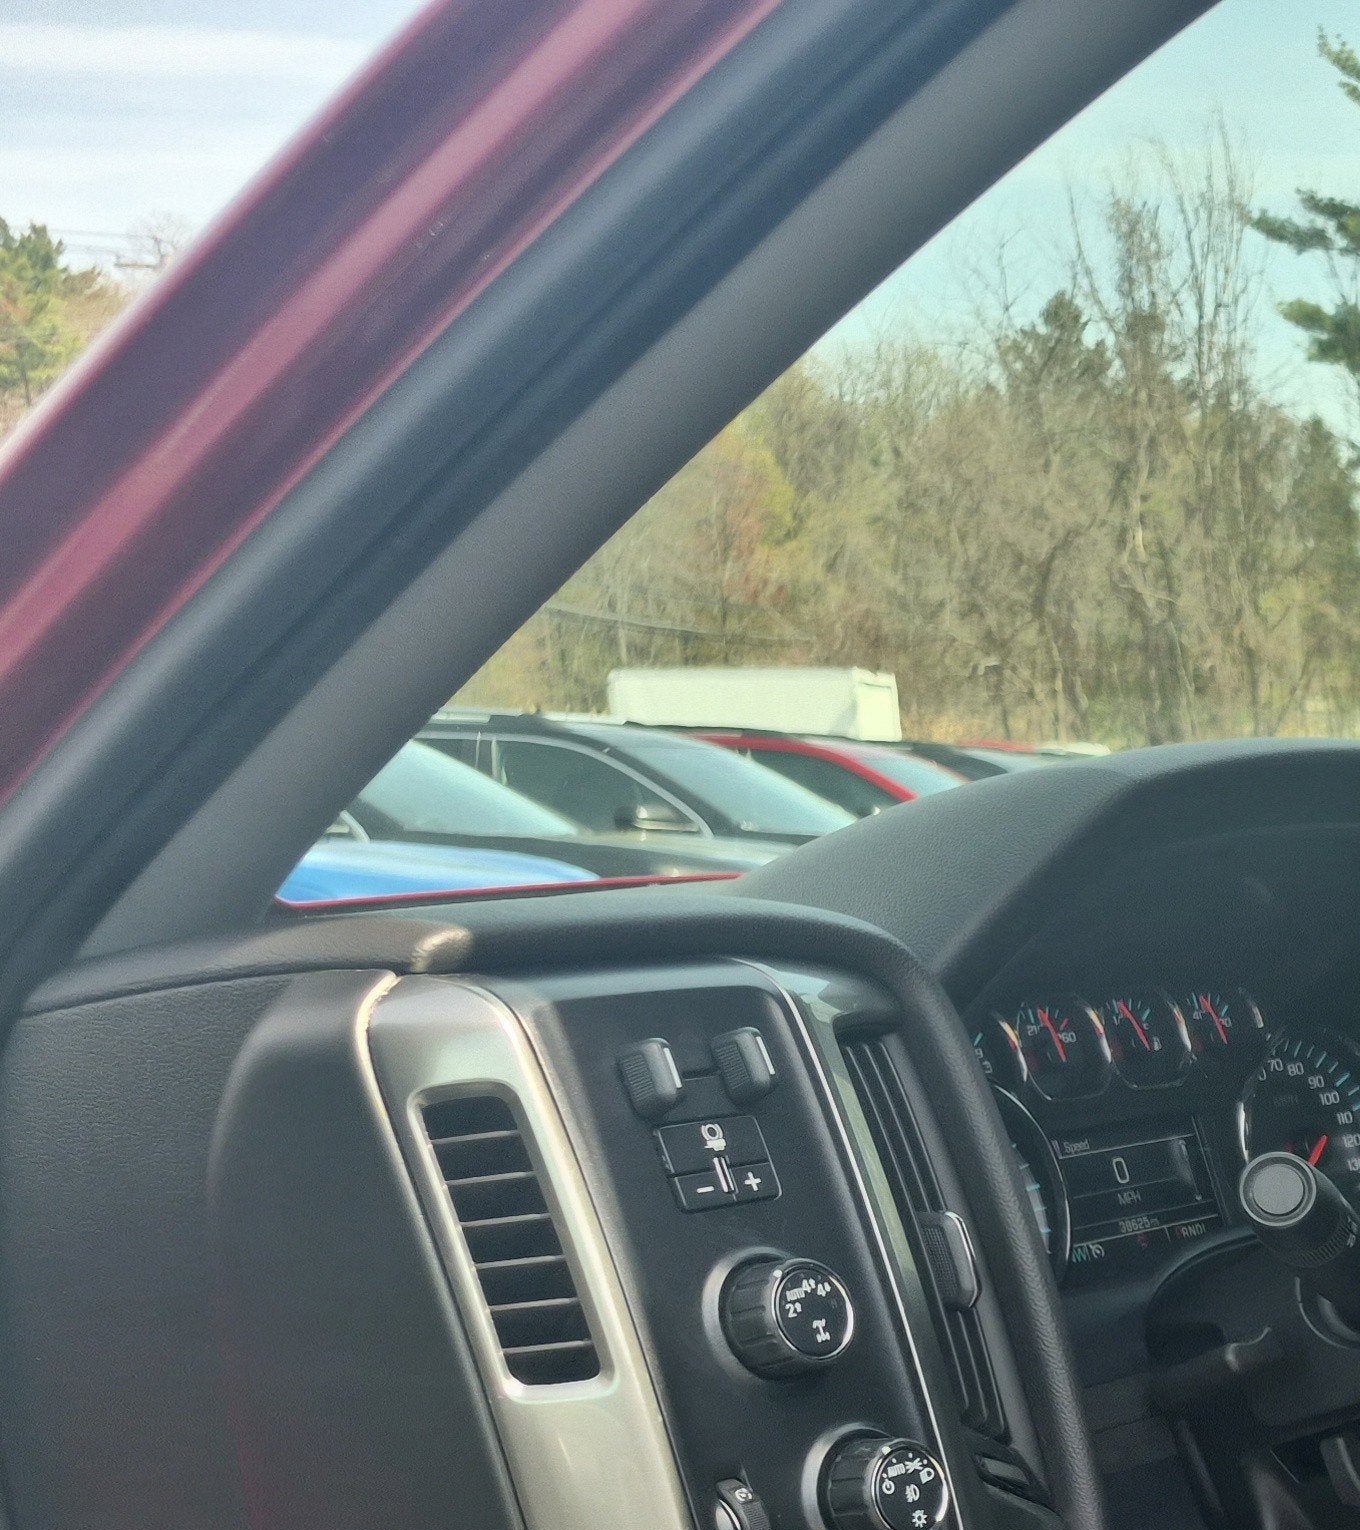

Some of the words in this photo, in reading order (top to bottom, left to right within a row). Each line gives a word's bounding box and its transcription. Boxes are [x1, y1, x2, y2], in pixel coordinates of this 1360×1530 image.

[1267, 1057, 1284, 1072] 70
[1287, 1061, 1305, 1077] 80
[1307, 1075, 1325, 1090] 90
[1319, 1090, 1340, 1106] 100
[1335, 1110, 1354, 1126] 110
[1063, 1138, 1091, 1155] Speed
[1112, 1156, 1131, 1185] 0
